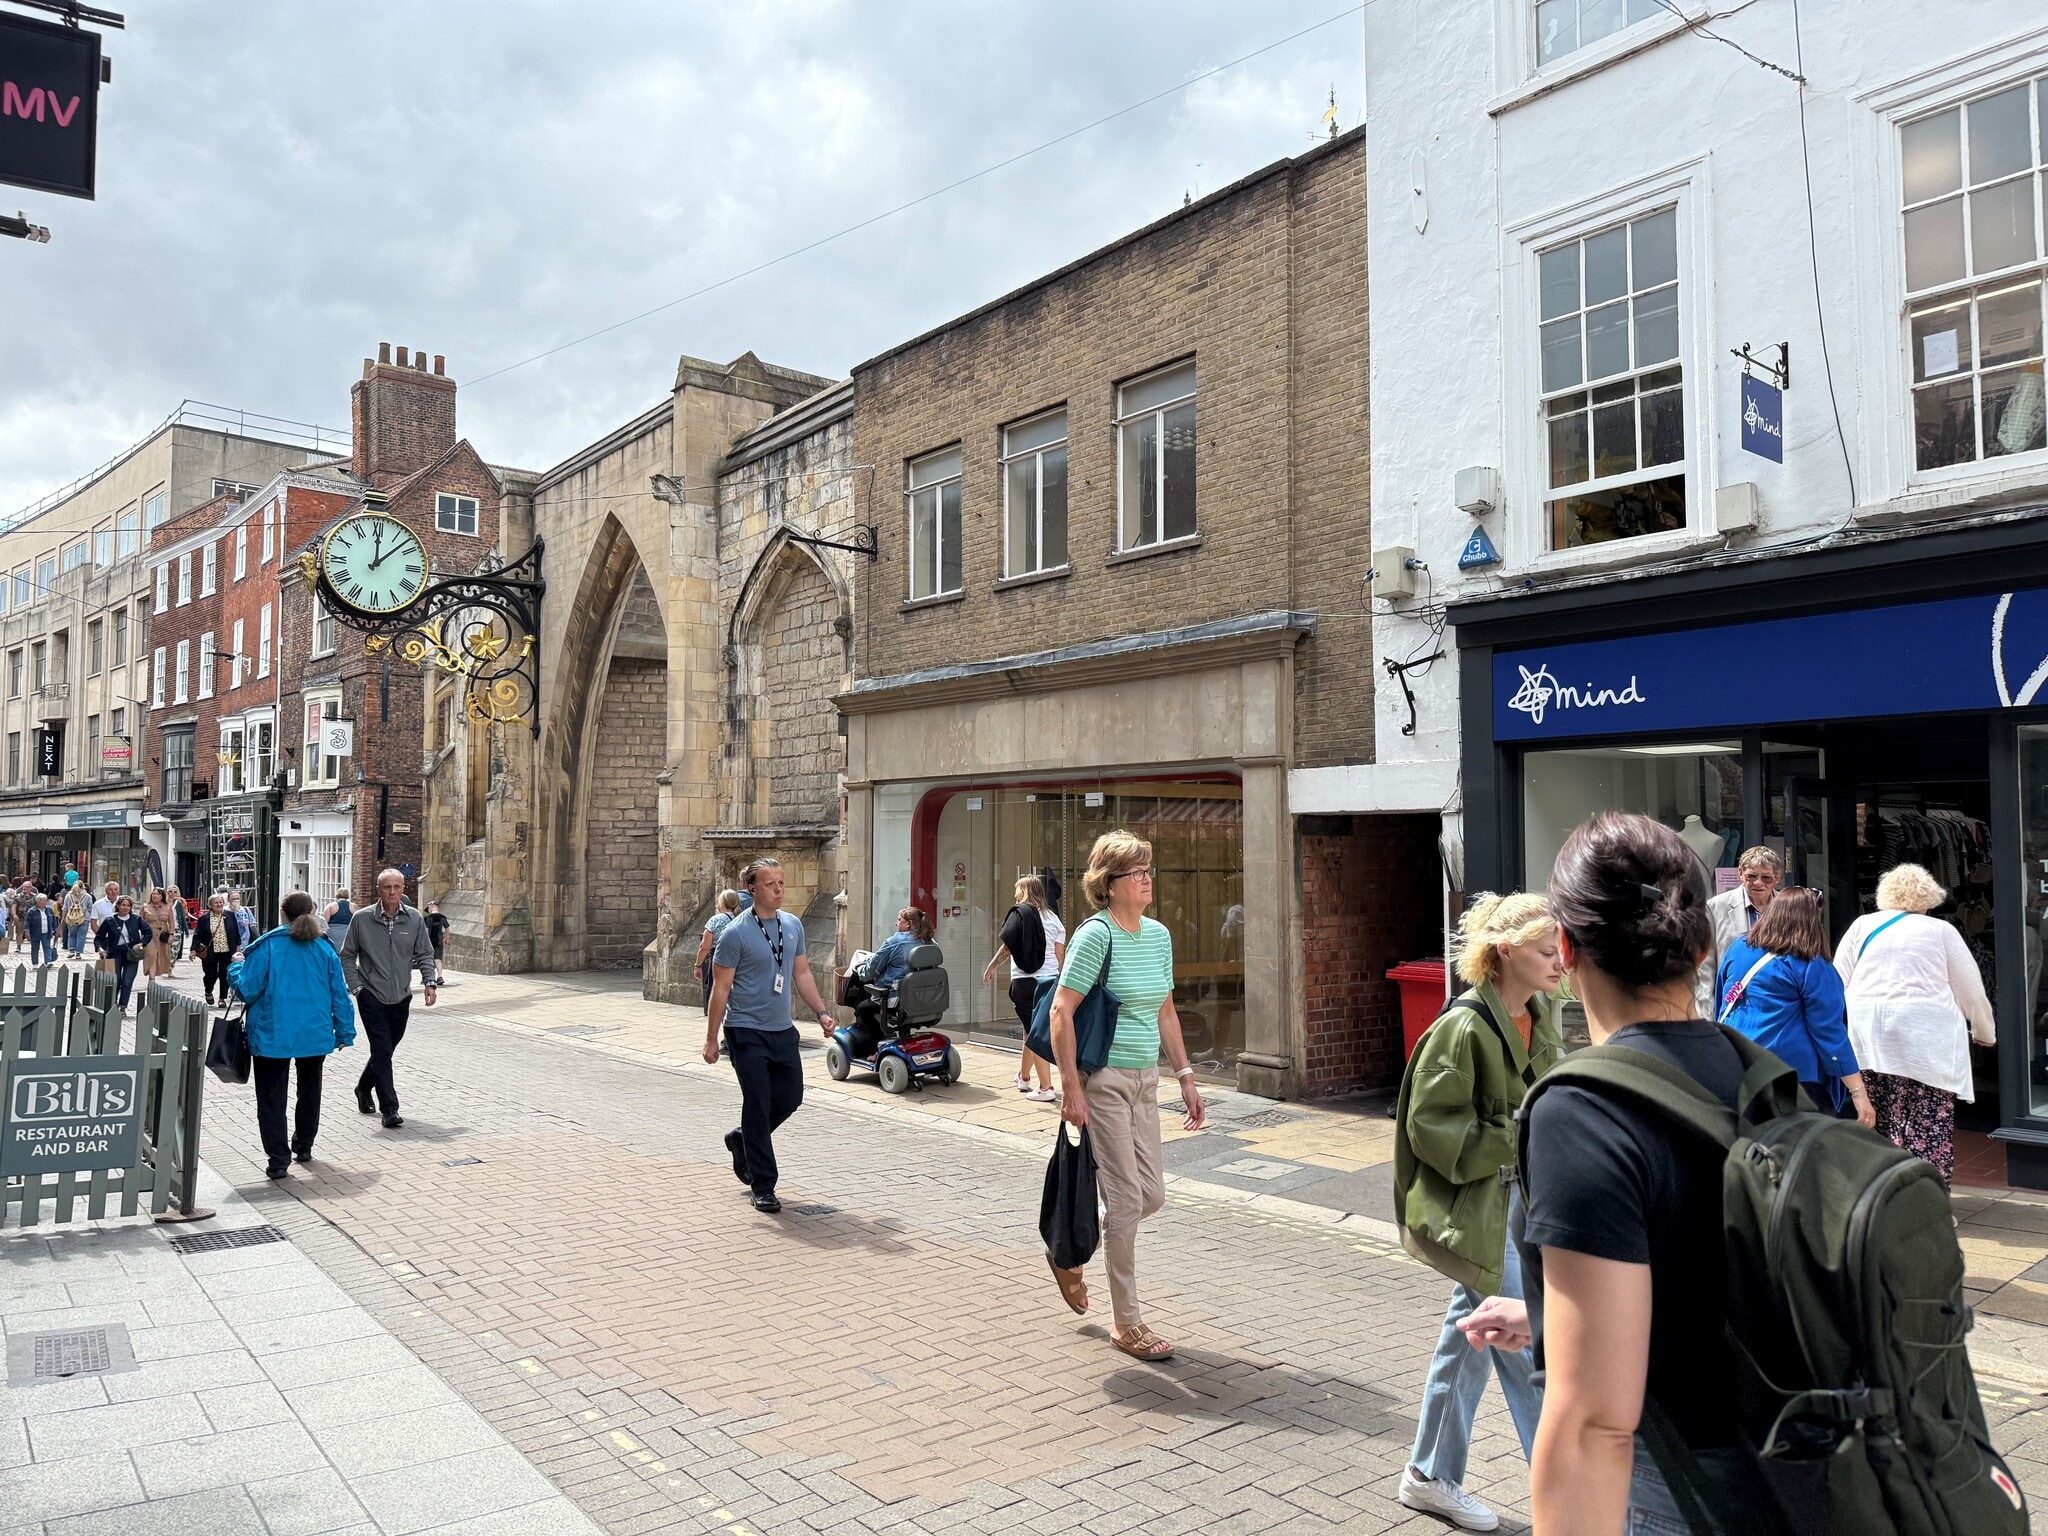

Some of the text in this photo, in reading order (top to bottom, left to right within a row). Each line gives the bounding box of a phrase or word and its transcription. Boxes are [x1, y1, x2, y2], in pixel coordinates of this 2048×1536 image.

[3, 81, 81, 128] MV
[1757, 416, 1781, 438] mind
[352, 523, 366, 540] XI
[336, 535, 353, 549] X
[1462, 552, 1488, 562] Chubb
[1555, 675, 1646, 709] mind
[329, 728, 348, 750] 3
[44, 735, 54, 771] NEXT
[46, 835, 66, 846] MONSOON
[24, 1072, 126, 1118] Bill's
[15, 1123, 127, 1142] RESTAURANT
[31, 1140, 109, 1156] AND BAR
